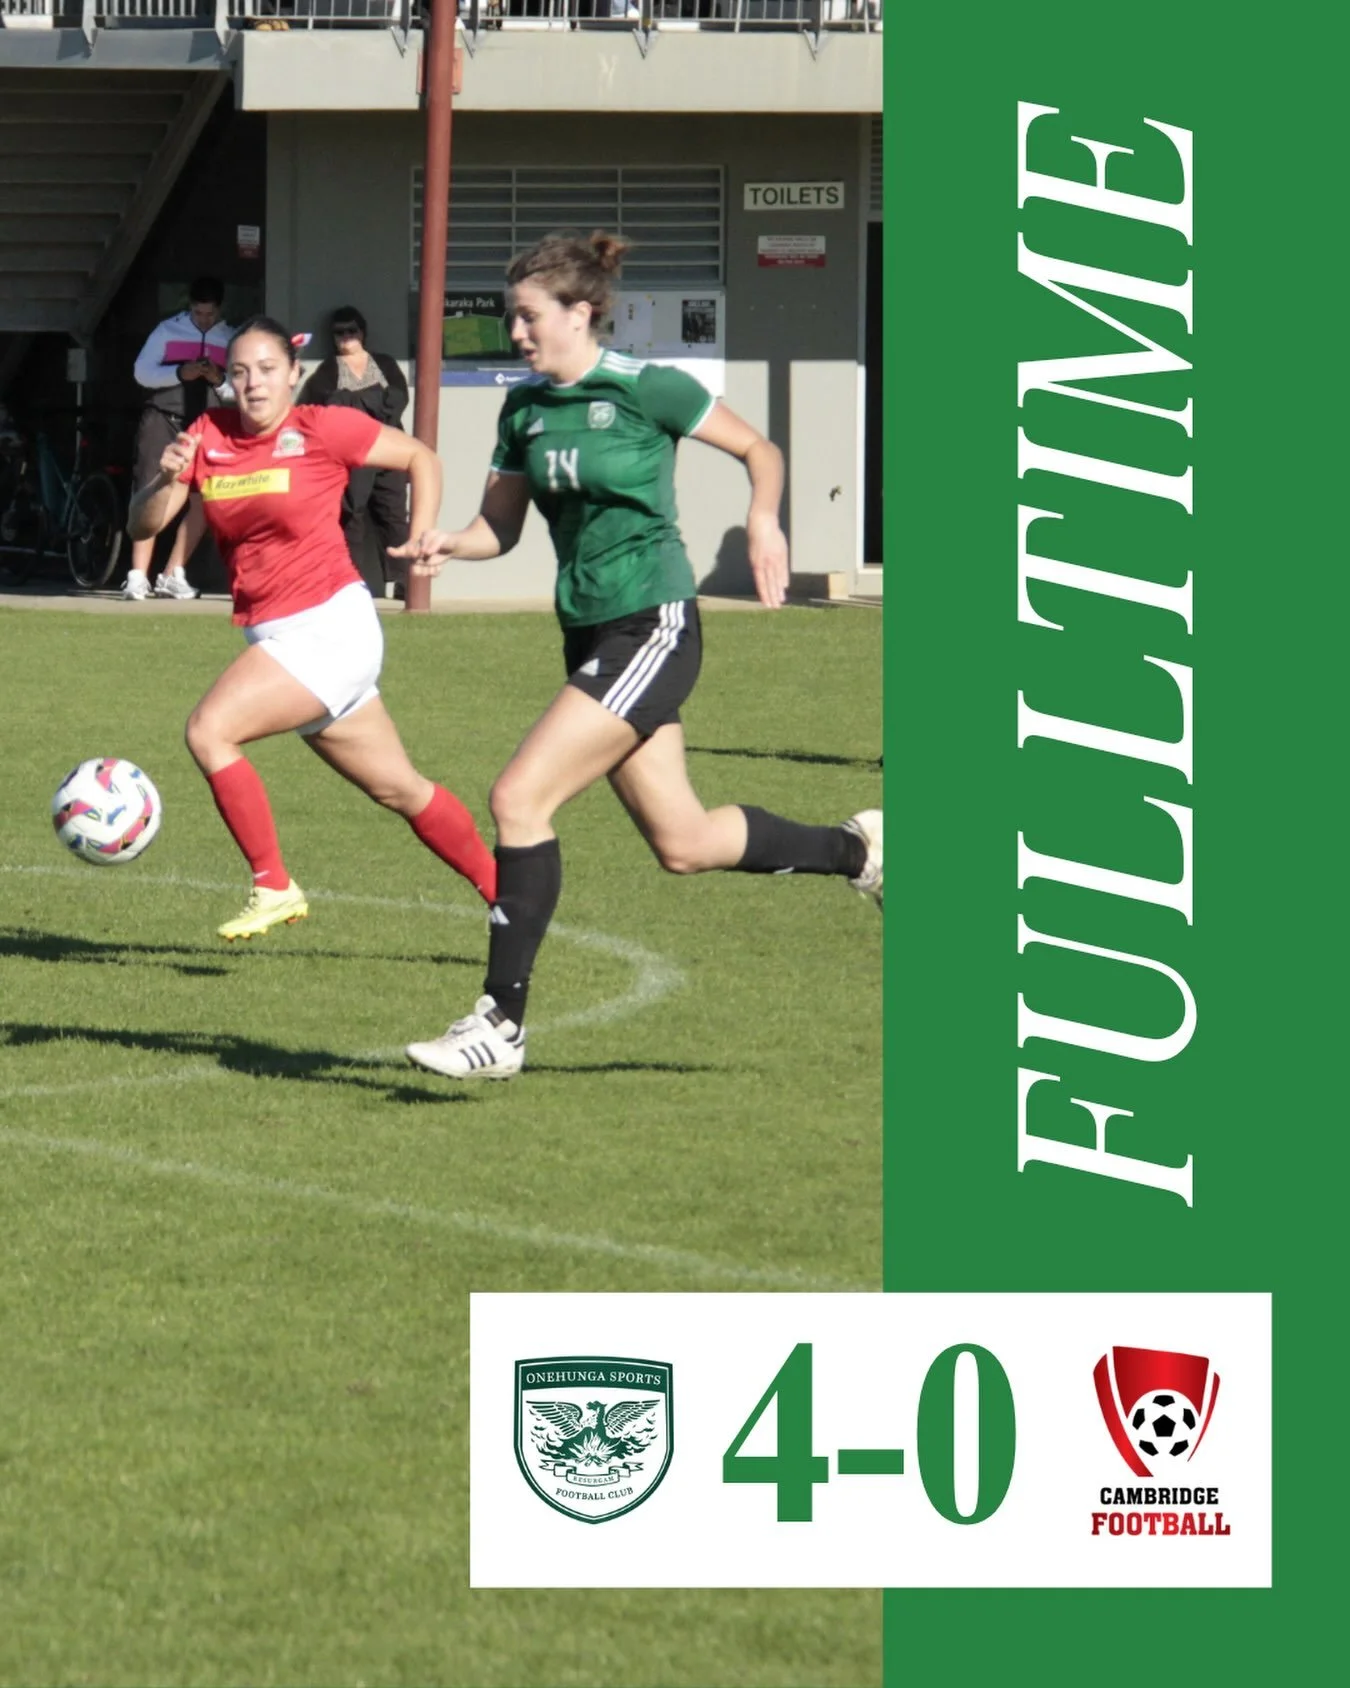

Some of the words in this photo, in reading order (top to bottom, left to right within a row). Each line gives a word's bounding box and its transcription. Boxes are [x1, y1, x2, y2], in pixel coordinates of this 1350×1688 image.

[749, 186, 839, 206] TOILETS
[475, 297, 496, 308] Park
[544, 448, 581, 491] 14
